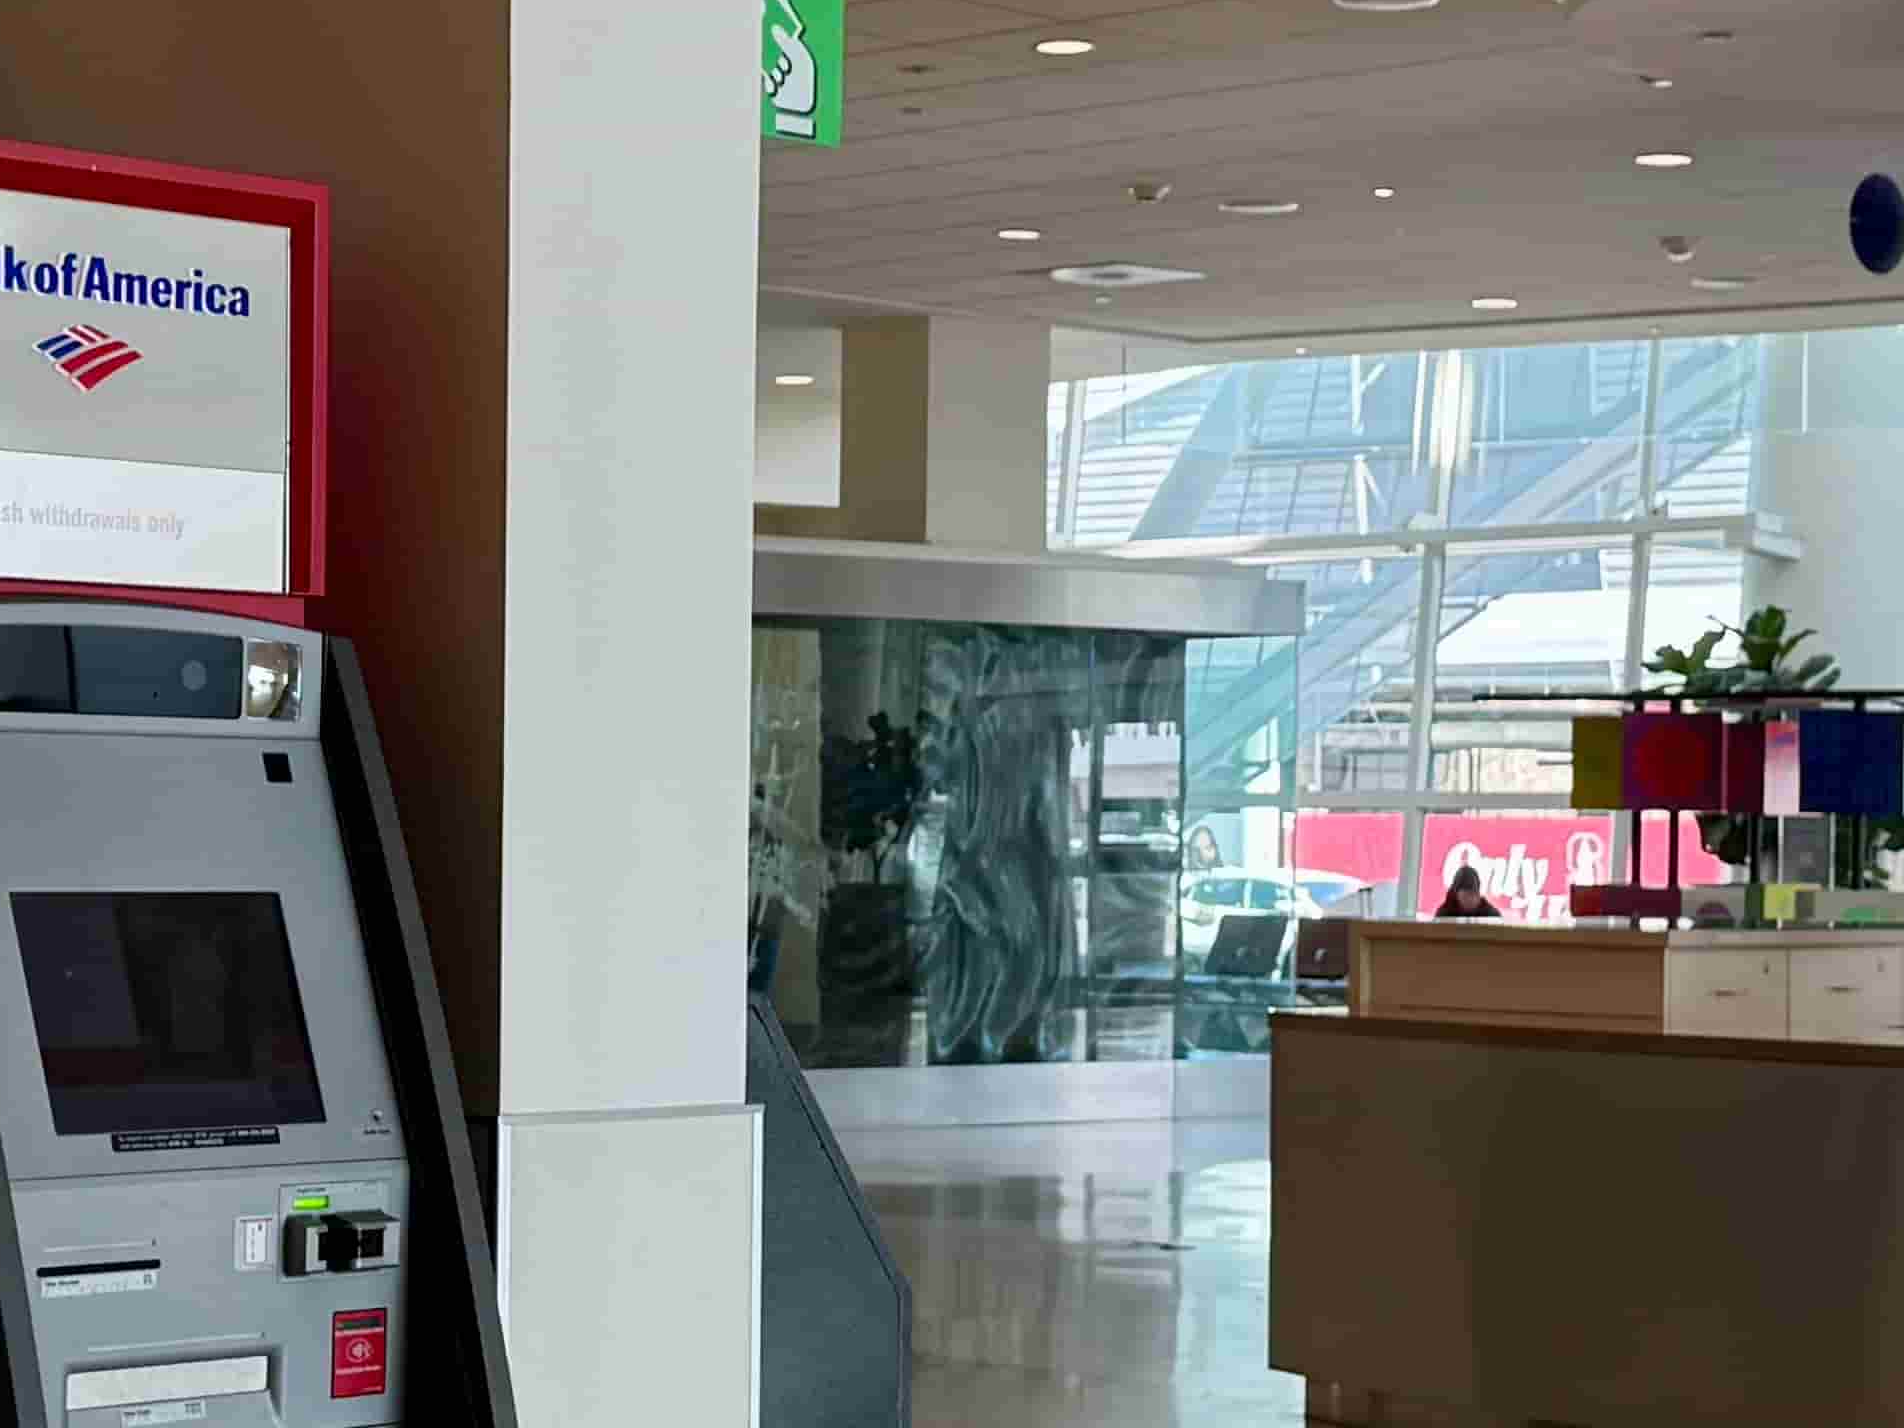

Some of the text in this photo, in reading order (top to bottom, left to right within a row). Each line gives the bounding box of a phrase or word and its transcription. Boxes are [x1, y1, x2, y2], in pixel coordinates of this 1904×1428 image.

[34, 253, 77, 296] of
[82, 257, 250, 317] America
[29, 505, 142, 533] withdrawals
[148, 512, 186, 540] only
